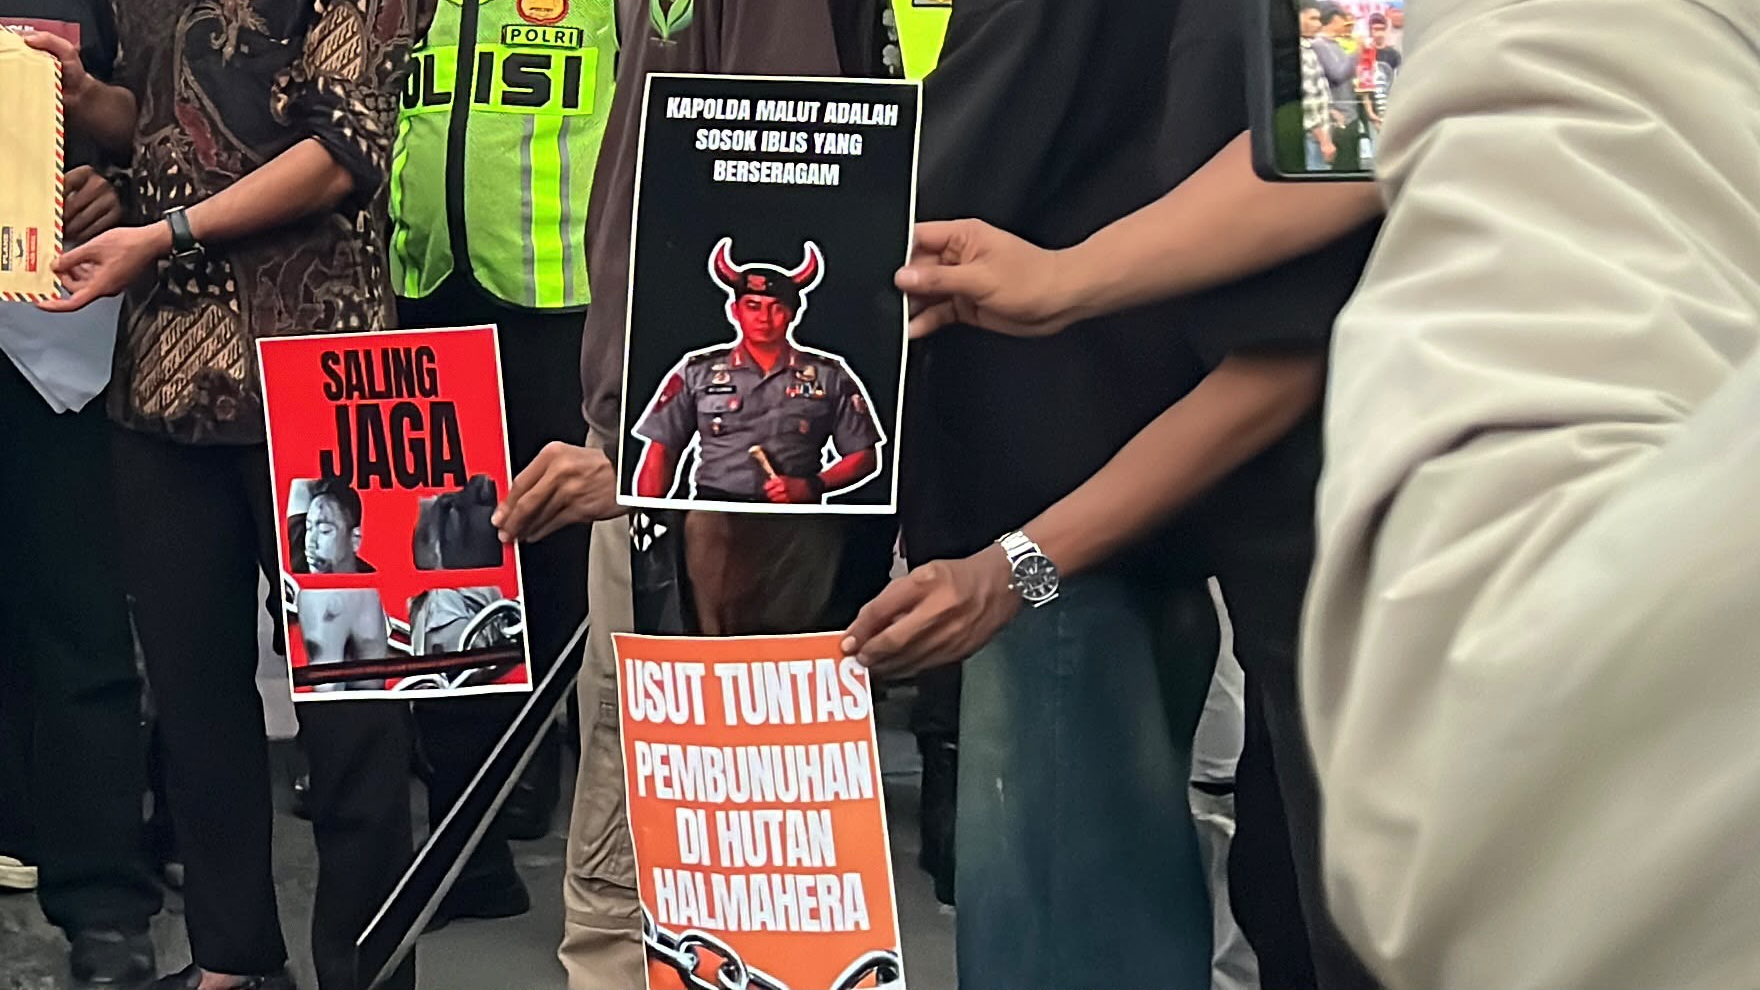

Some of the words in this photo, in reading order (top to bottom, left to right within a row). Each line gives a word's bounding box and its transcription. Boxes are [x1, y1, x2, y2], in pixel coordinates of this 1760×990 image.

[510, 28, 575, 45] POLRI
[402, 52, 583, 109] OLISI
[666, 96, 750, 121] KAPOLDA
[755, 99, 821, 123] MALUT
[823, 102, 899, 126] ADALAH
[695, 128, 758, 152] SOSOK
[760, 130, 808, 154] IBLIS
[813, 132, 863, 156] YANG
[713, 159, 840, 187] BERSERAGAM
[320, 345, 440, 402] SALING
[319, 401, 468, 491] JAGA
[625, 658, 706, 726] USUT
[714, 656, 871, 726] TUNTAS
[634, 740, 874, 804] PEMBUNUHAN
[676, 807, 711, 867] DI
[715, 809, 837, 868] HUTAN
[653, 866, 871, 932] HALMAHERA
